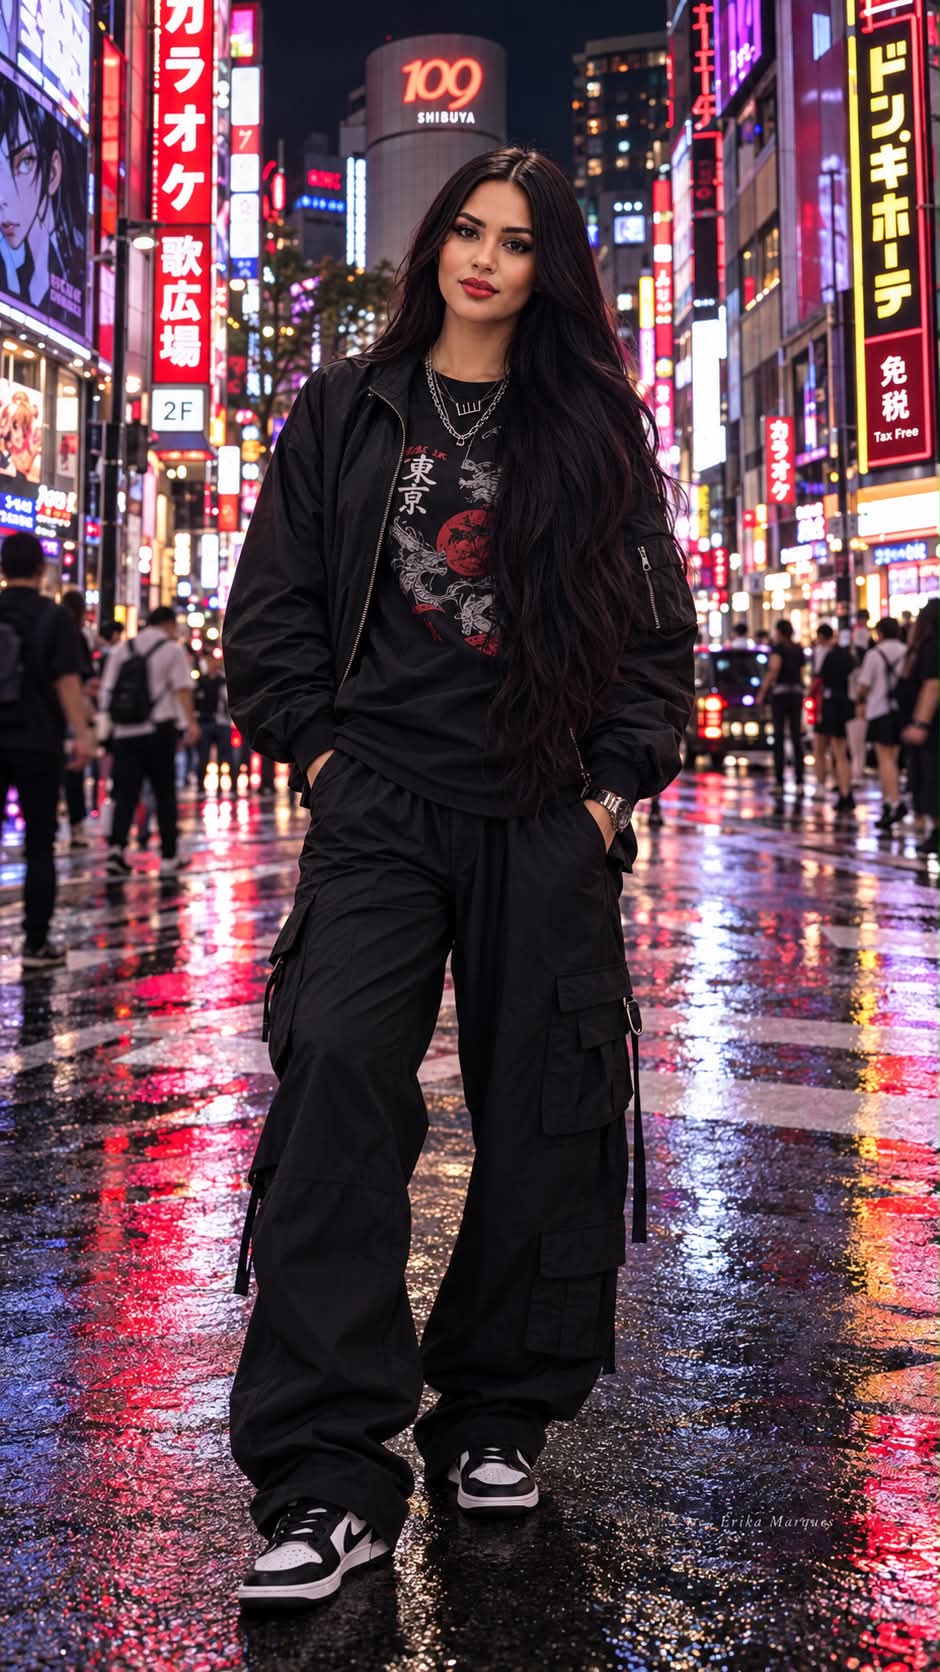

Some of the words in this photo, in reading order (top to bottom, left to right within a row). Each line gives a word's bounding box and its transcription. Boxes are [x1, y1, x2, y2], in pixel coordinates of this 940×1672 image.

[163, 0, 206, 211] カラオケ
[401, 56, 483, 110] 109
[417, 111, 475, 124] SHIBUYA
[159, 235, 203, 368] 歌広場
[163, 401, 193, 421] 2F
[880, 355, 910, 422] 免税
[770, 419, 791, 502] カラオケ
[873, 431, 893, 443] Tax
[895, 427, 919, 439] Free
[398, 453, 437, 515] 東京
